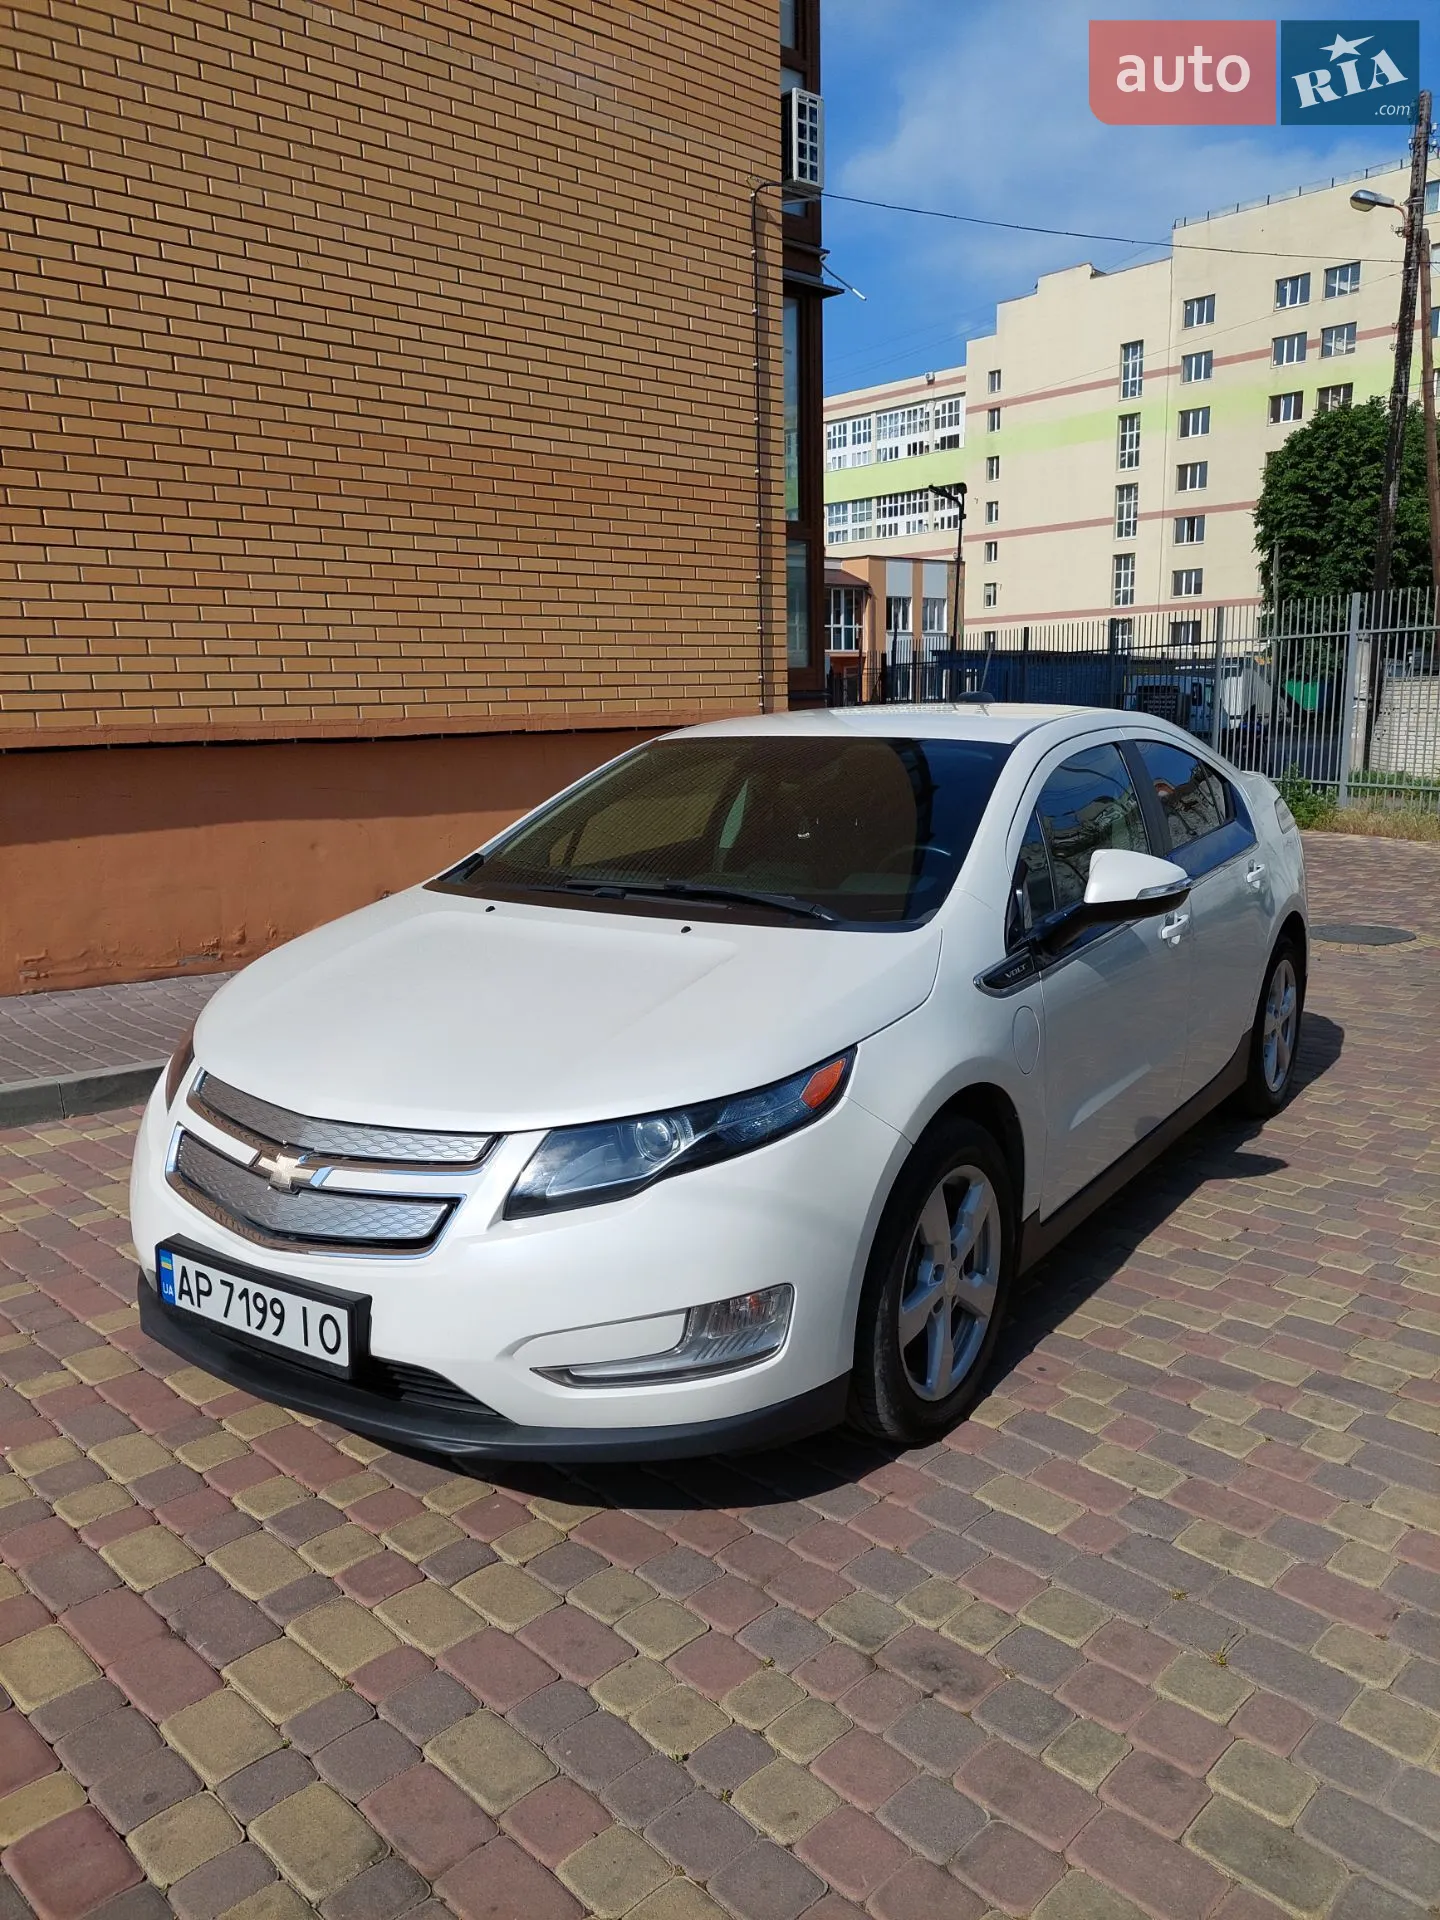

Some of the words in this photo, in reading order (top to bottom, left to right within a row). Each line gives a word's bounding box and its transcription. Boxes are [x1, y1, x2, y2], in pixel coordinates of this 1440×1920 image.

[1005, 963, 1027, 978] VOLT
[162, 1282, 175, 1297] UA
[178, 1265, 213, 1308] AP
[220, 1279, 286, 1337] 7199
[302, 1306, 342, 1355] IO
